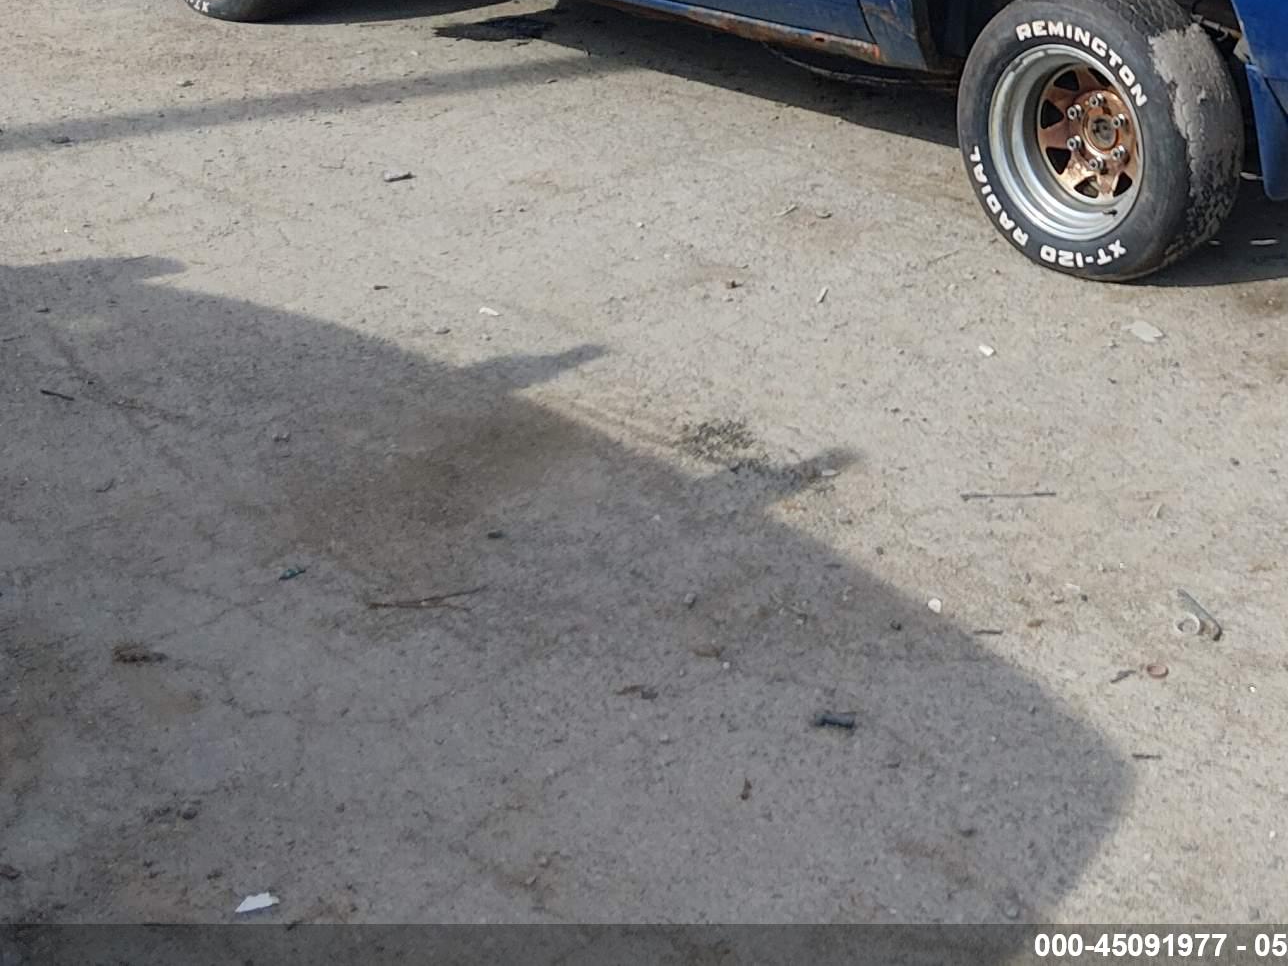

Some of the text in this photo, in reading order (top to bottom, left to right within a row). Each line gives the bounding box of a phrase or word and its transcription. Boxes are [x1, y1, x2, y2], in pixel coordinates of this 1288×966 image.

[1015, 20, 1147, 107] REMINGTON
[967, 145, 1029, 248] RADIAL
[1040, 238, 1127, 269] XT-120
